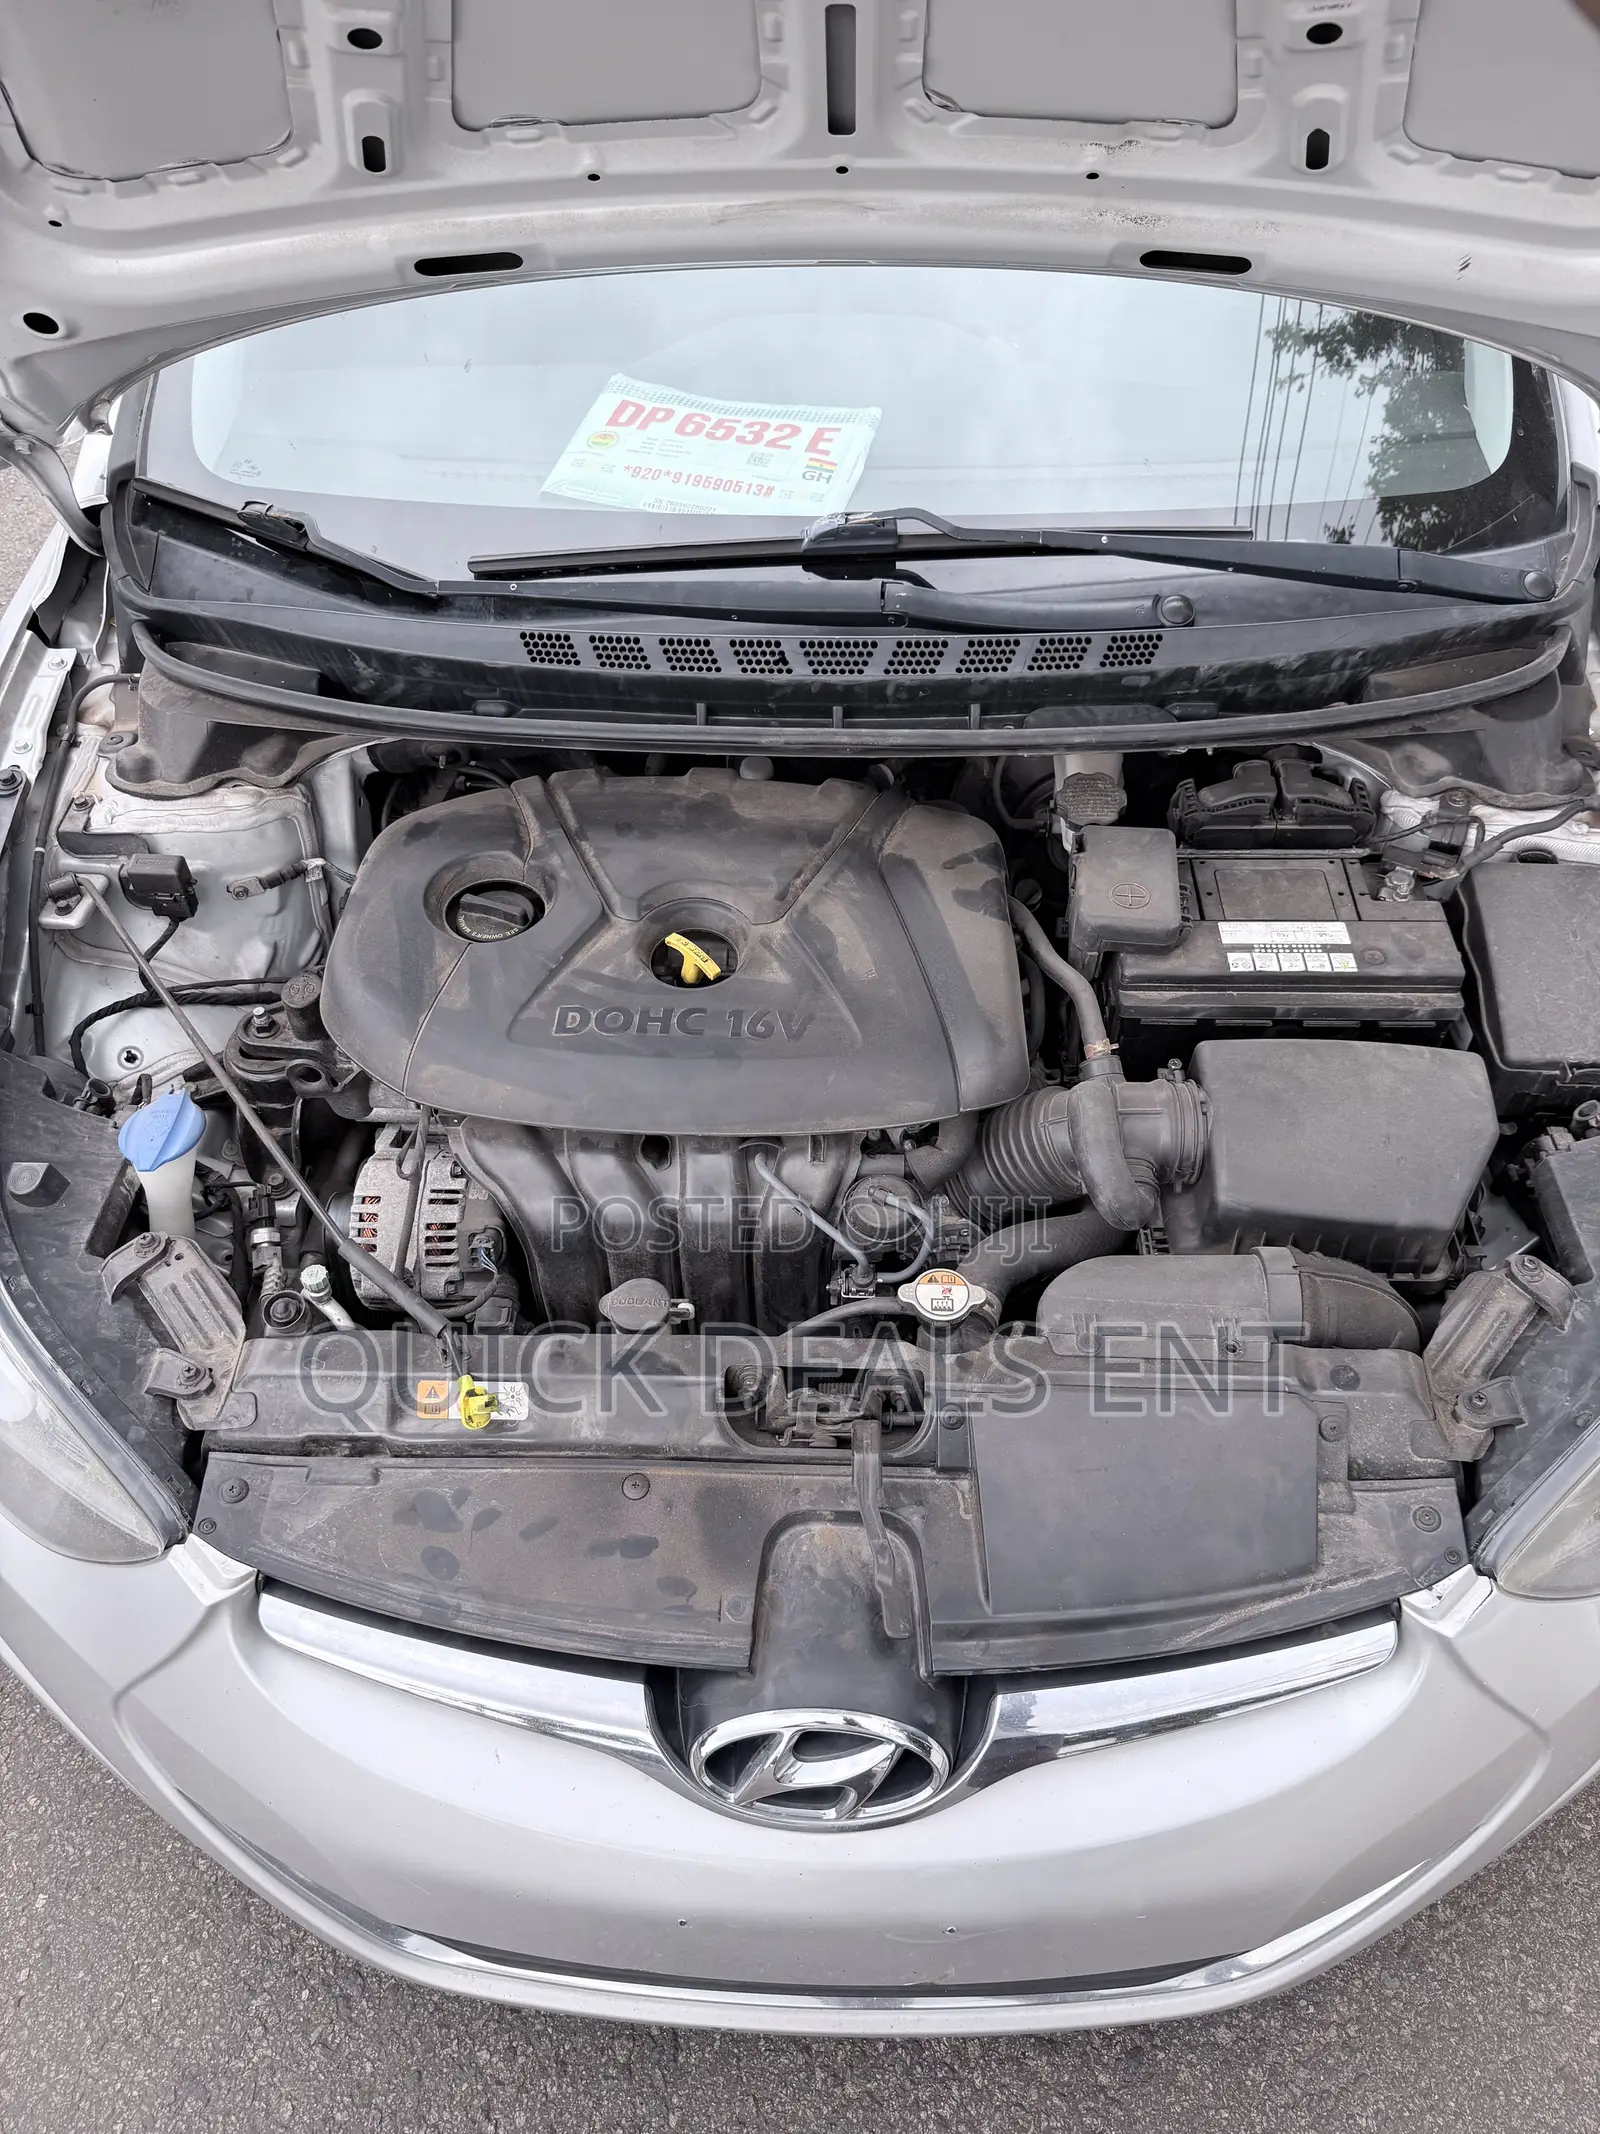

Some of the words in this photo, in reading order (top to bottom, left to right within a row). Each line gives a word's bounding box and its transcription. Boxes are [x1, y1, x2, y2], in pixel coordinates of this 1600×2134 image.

[605, 399, 675, 430] DP
[674, 412, 802, 450] 6532
[804, 427, 842, 457] E
[801, 470, 833, 485] GH
[458, 915, 472, 934] MANUAL
[505, 927, 519, 936] SEE
[471, 931, 503, 939] OWNER'S
[552, 1004, 710, 1037] DOHC
[726, 1009, 817, 1042] 16V
